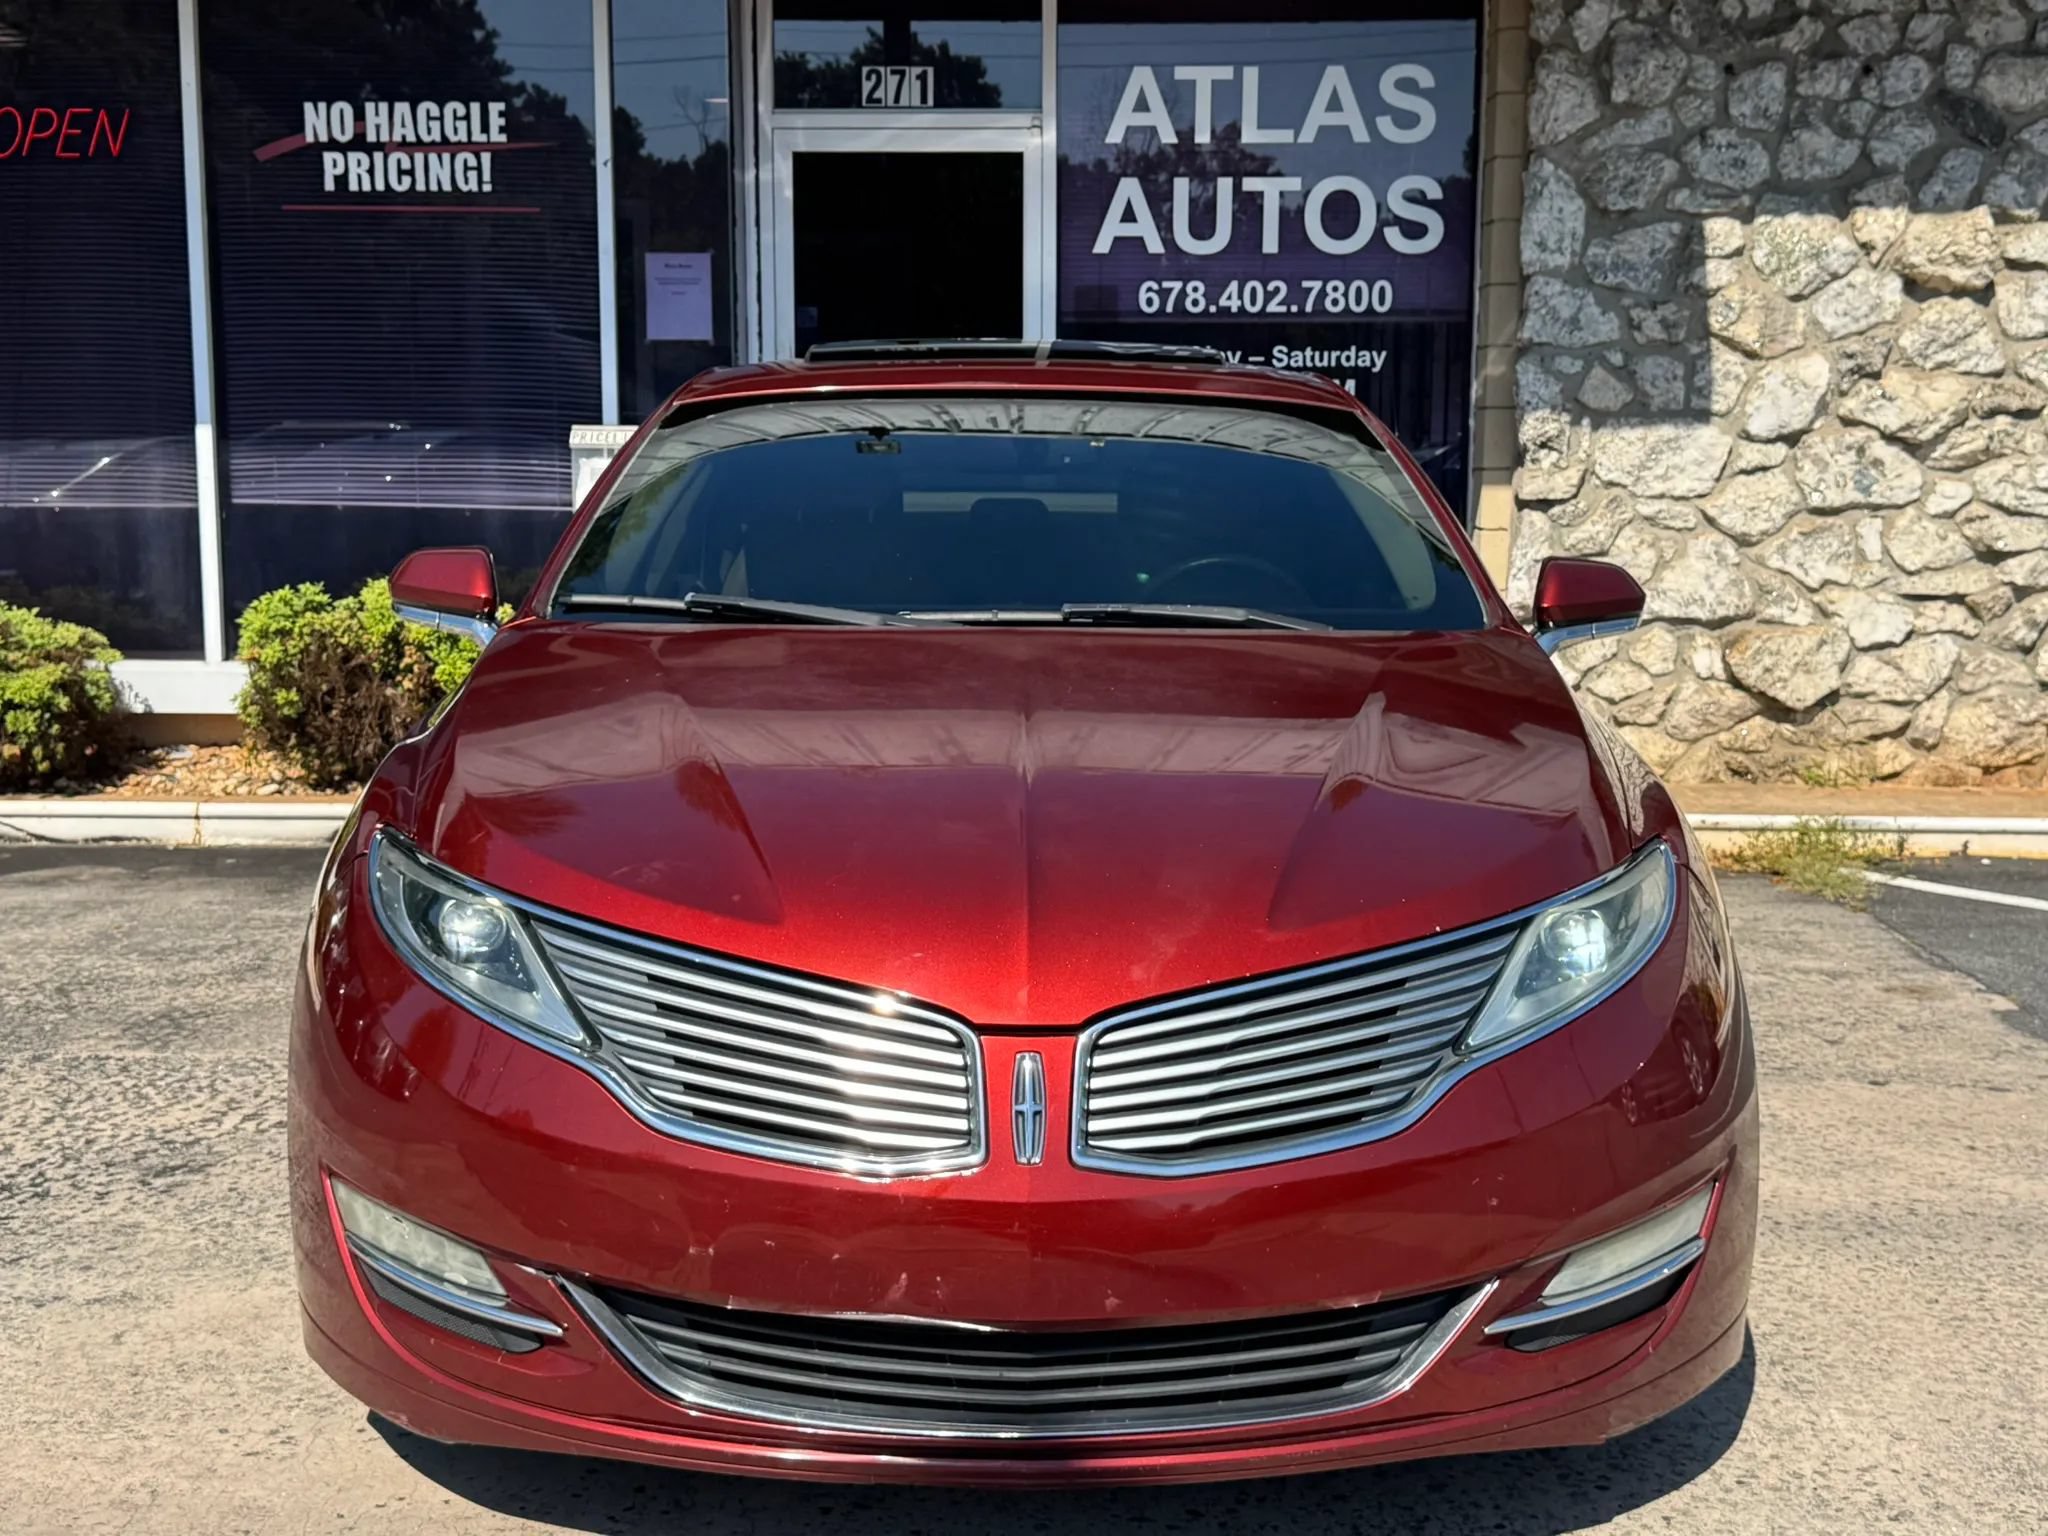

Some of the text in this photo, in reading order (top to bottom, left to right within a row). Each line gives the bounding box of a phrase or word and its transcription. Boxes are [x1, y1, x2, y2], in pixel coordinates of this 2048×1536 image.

[864, 68, 930, 105] 271
[1104, 63, 1437, 144] ATLAS
[0, 106, 130, 158] OPEN
[303, 101, 508, 142] NO HAGGLE
[322, 151, 493, 192] PRICING!
[1091, 175, 1445, 255] AUTOS
[1137, 280, 1393, 313] 678.402.7800
[1271, 345, 1387, 373] Saturday
